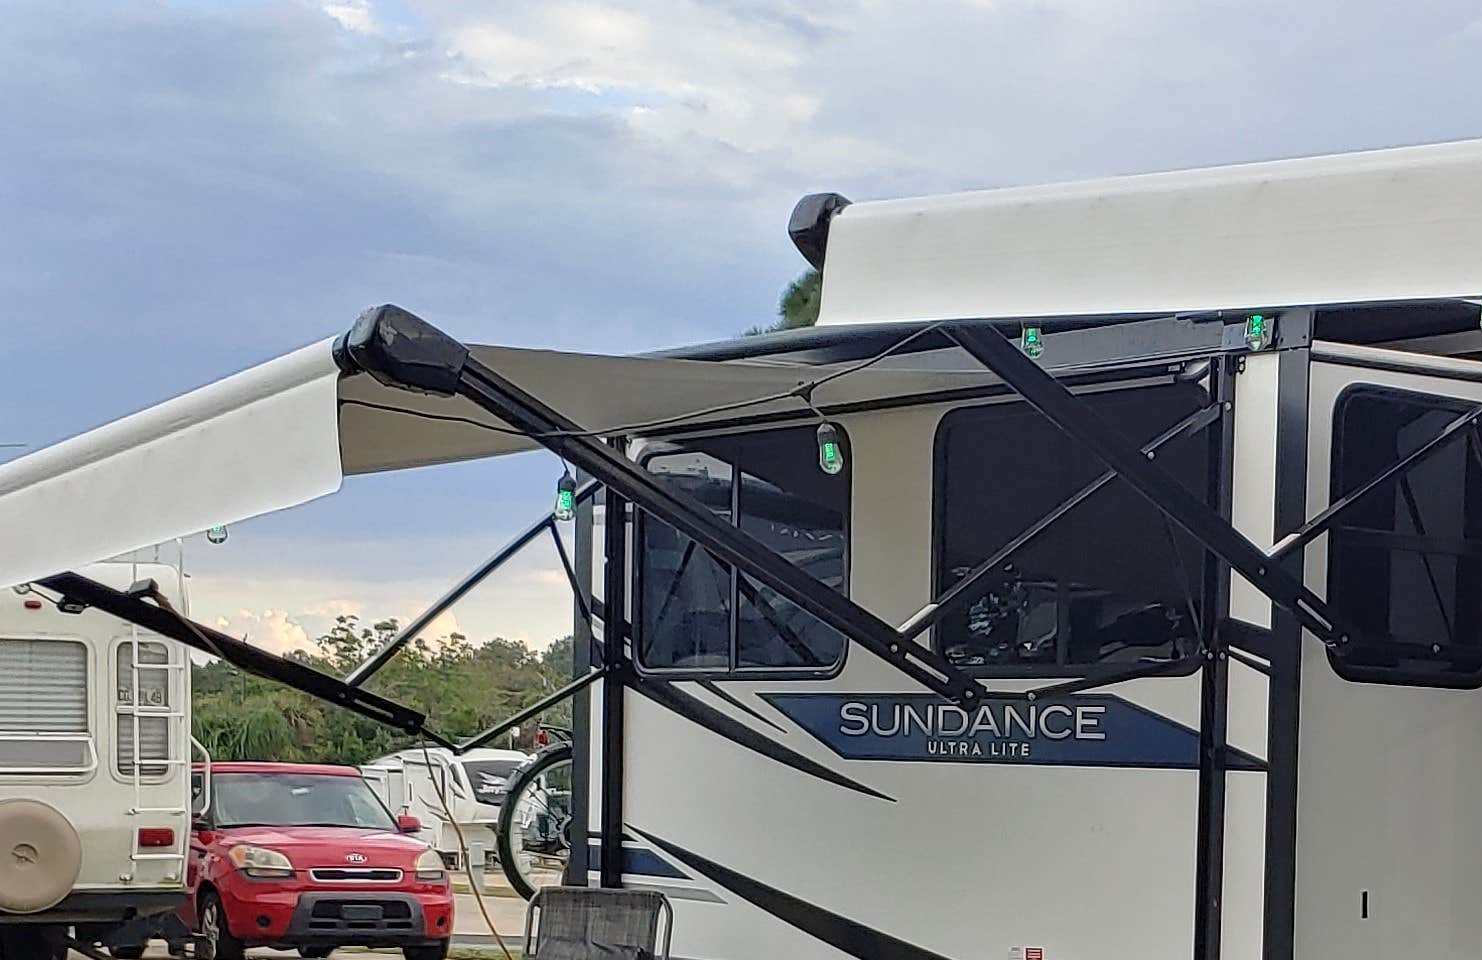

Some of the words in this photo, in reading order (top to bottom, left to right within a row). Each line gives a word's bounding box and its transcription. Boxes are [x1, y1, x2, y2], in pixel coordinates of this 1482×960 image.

[839, 702, 1107, 740] SUNDANCE
[927, 740, 982, 756] ULTRA
[990, 742, 1031, 757] LITE
